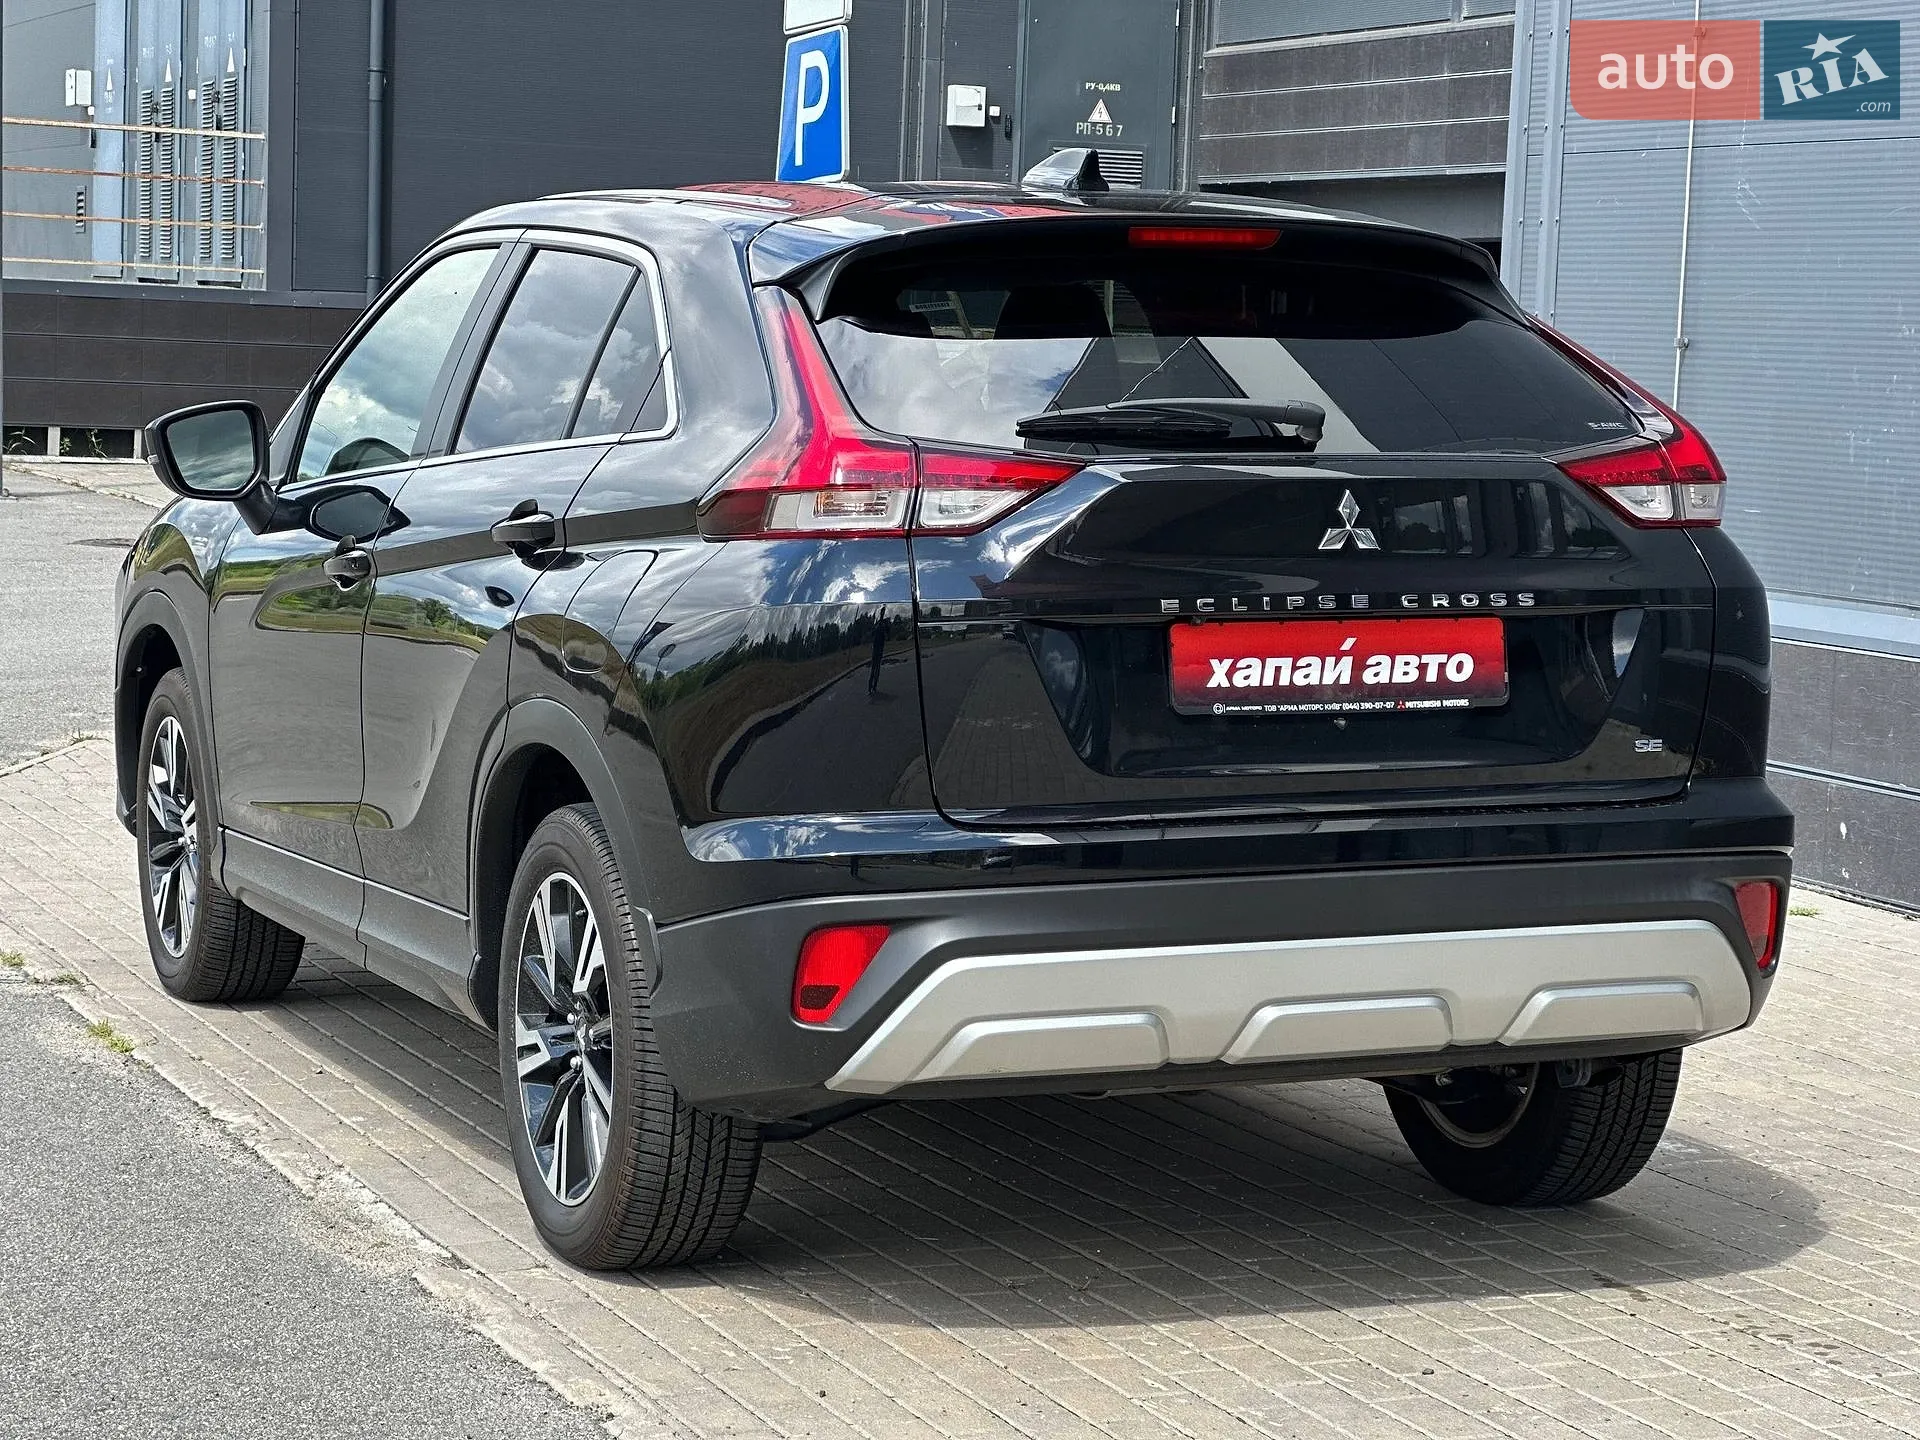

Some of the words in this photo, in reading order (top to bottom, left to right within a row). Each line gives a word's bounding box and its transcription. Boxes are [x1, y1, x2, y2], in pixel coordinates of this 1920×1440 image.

[795, 49, 830, 167] P
[1160, 594, 1369, 613] ECLIPSE
[1401, 592, 1535, 608] CROSS
[1206, 637, 1358, 688] хапай
[1362, 652, 1475, 685] авто
[1342, 701, 1359, 710] (044)
[1360, 701, 1395, 710] 390-07-07
[1405, 700, 1441, 708] MITSUBISHI
[1442, 698, 1470, 707] MOTORS
[1634, 739, 1663, 752] SE
